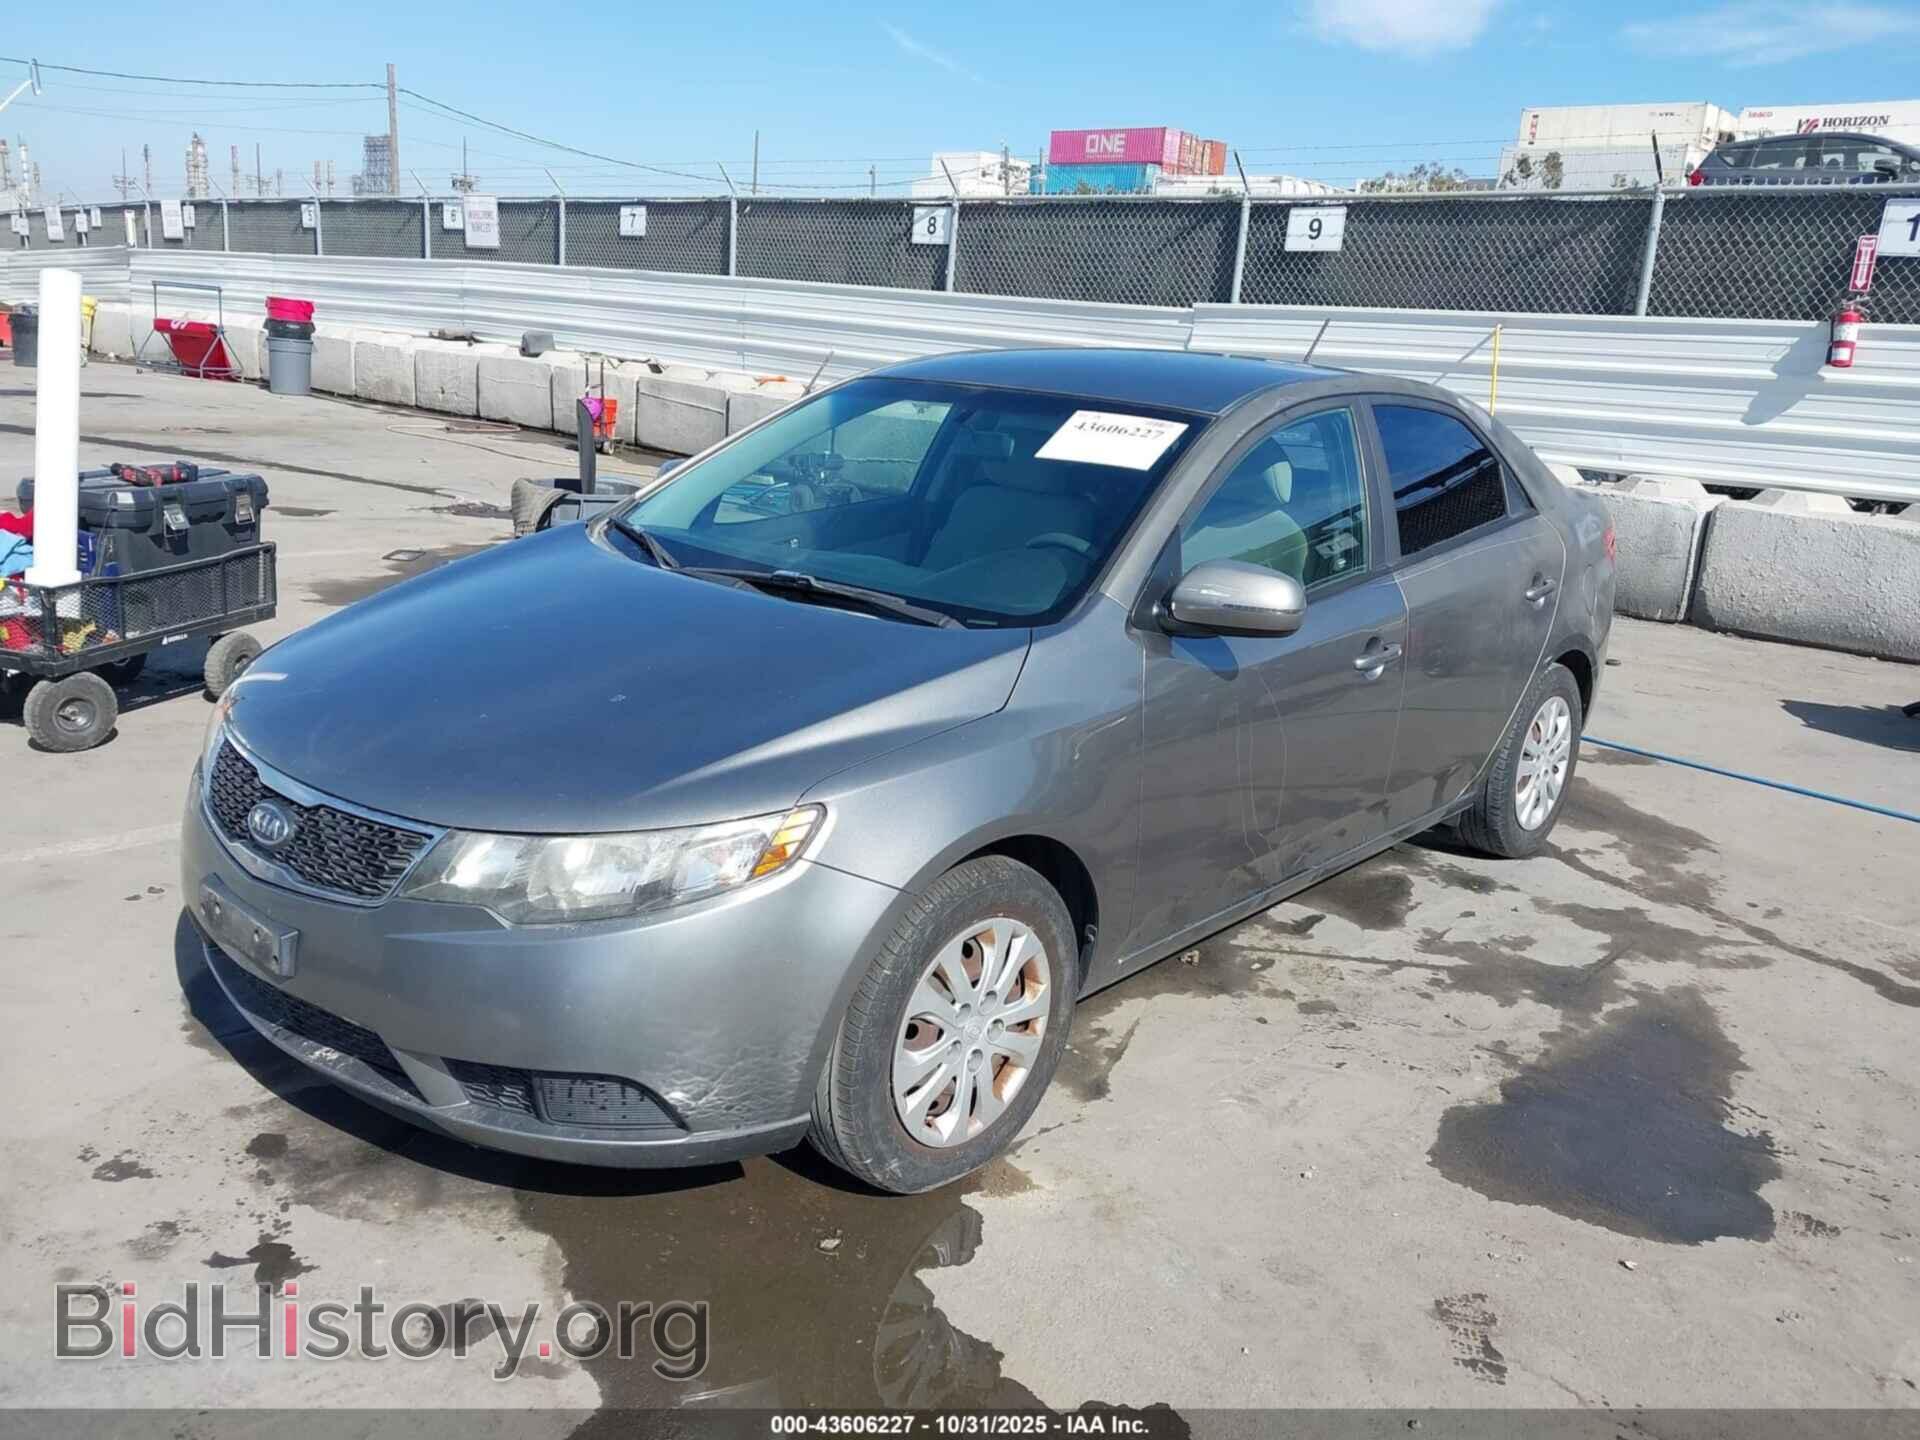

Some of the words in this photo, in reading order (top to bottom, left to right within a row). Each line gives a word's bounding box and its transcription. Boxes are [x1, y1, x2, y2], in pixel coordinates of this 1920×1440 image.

[1822, 115, 1890, 127] HORIZON
[1086, 134, 1125, 153] ONE
[629, 212, 637, 228] 7
[927, 216, 937, 235] 8
[1308, 218, 1322, 240] 9
